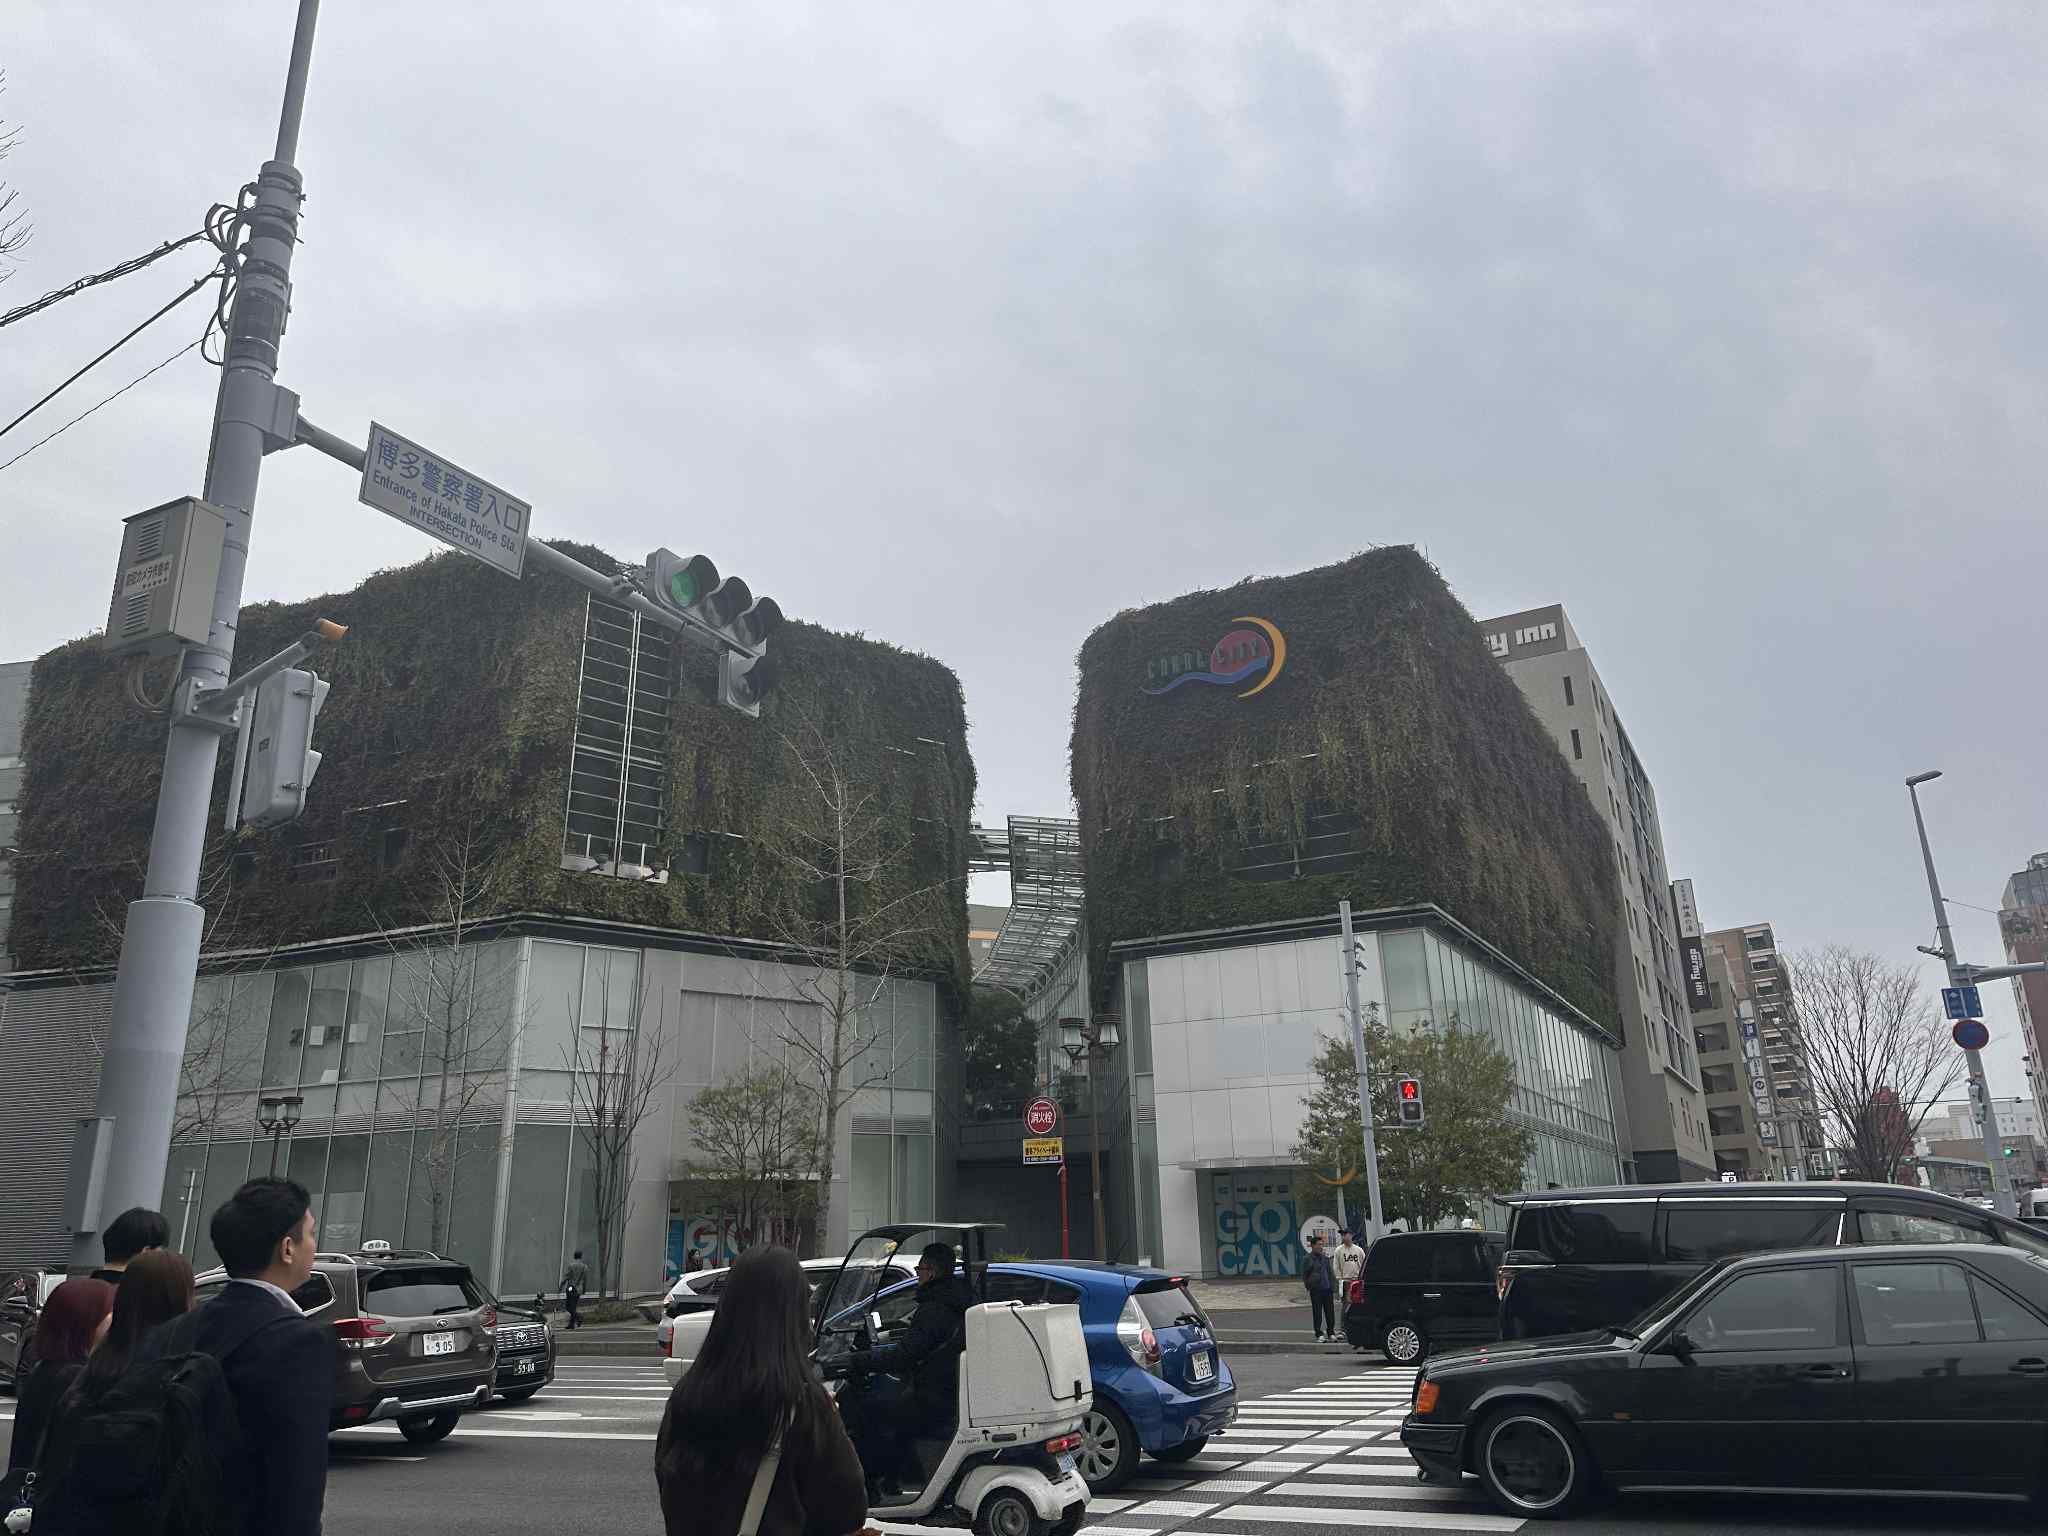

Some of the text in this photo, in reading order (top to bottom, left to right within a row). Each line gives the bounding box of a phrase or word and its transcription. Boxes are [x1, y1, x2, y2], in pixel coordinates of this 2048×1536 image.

[378, 436, 522, 534] 博多警察署入口
[373, 471, 417, 503] Entrance
[421, 496, 431, 510] of
[434, 500, 467, 528] Hakata
[470, 518, 498, 543] Police
[410, 506, 482, 550] INTERSECTION
[1515, 622, 1557, 645] inn
[1030, 1111, 1053, 1124] 消火栓
[1215, 1201, 1291, 1243] GO
[1216, 1243, 1297, 1275] CAN
[1343, 1252, 1358, 1263] Lee
